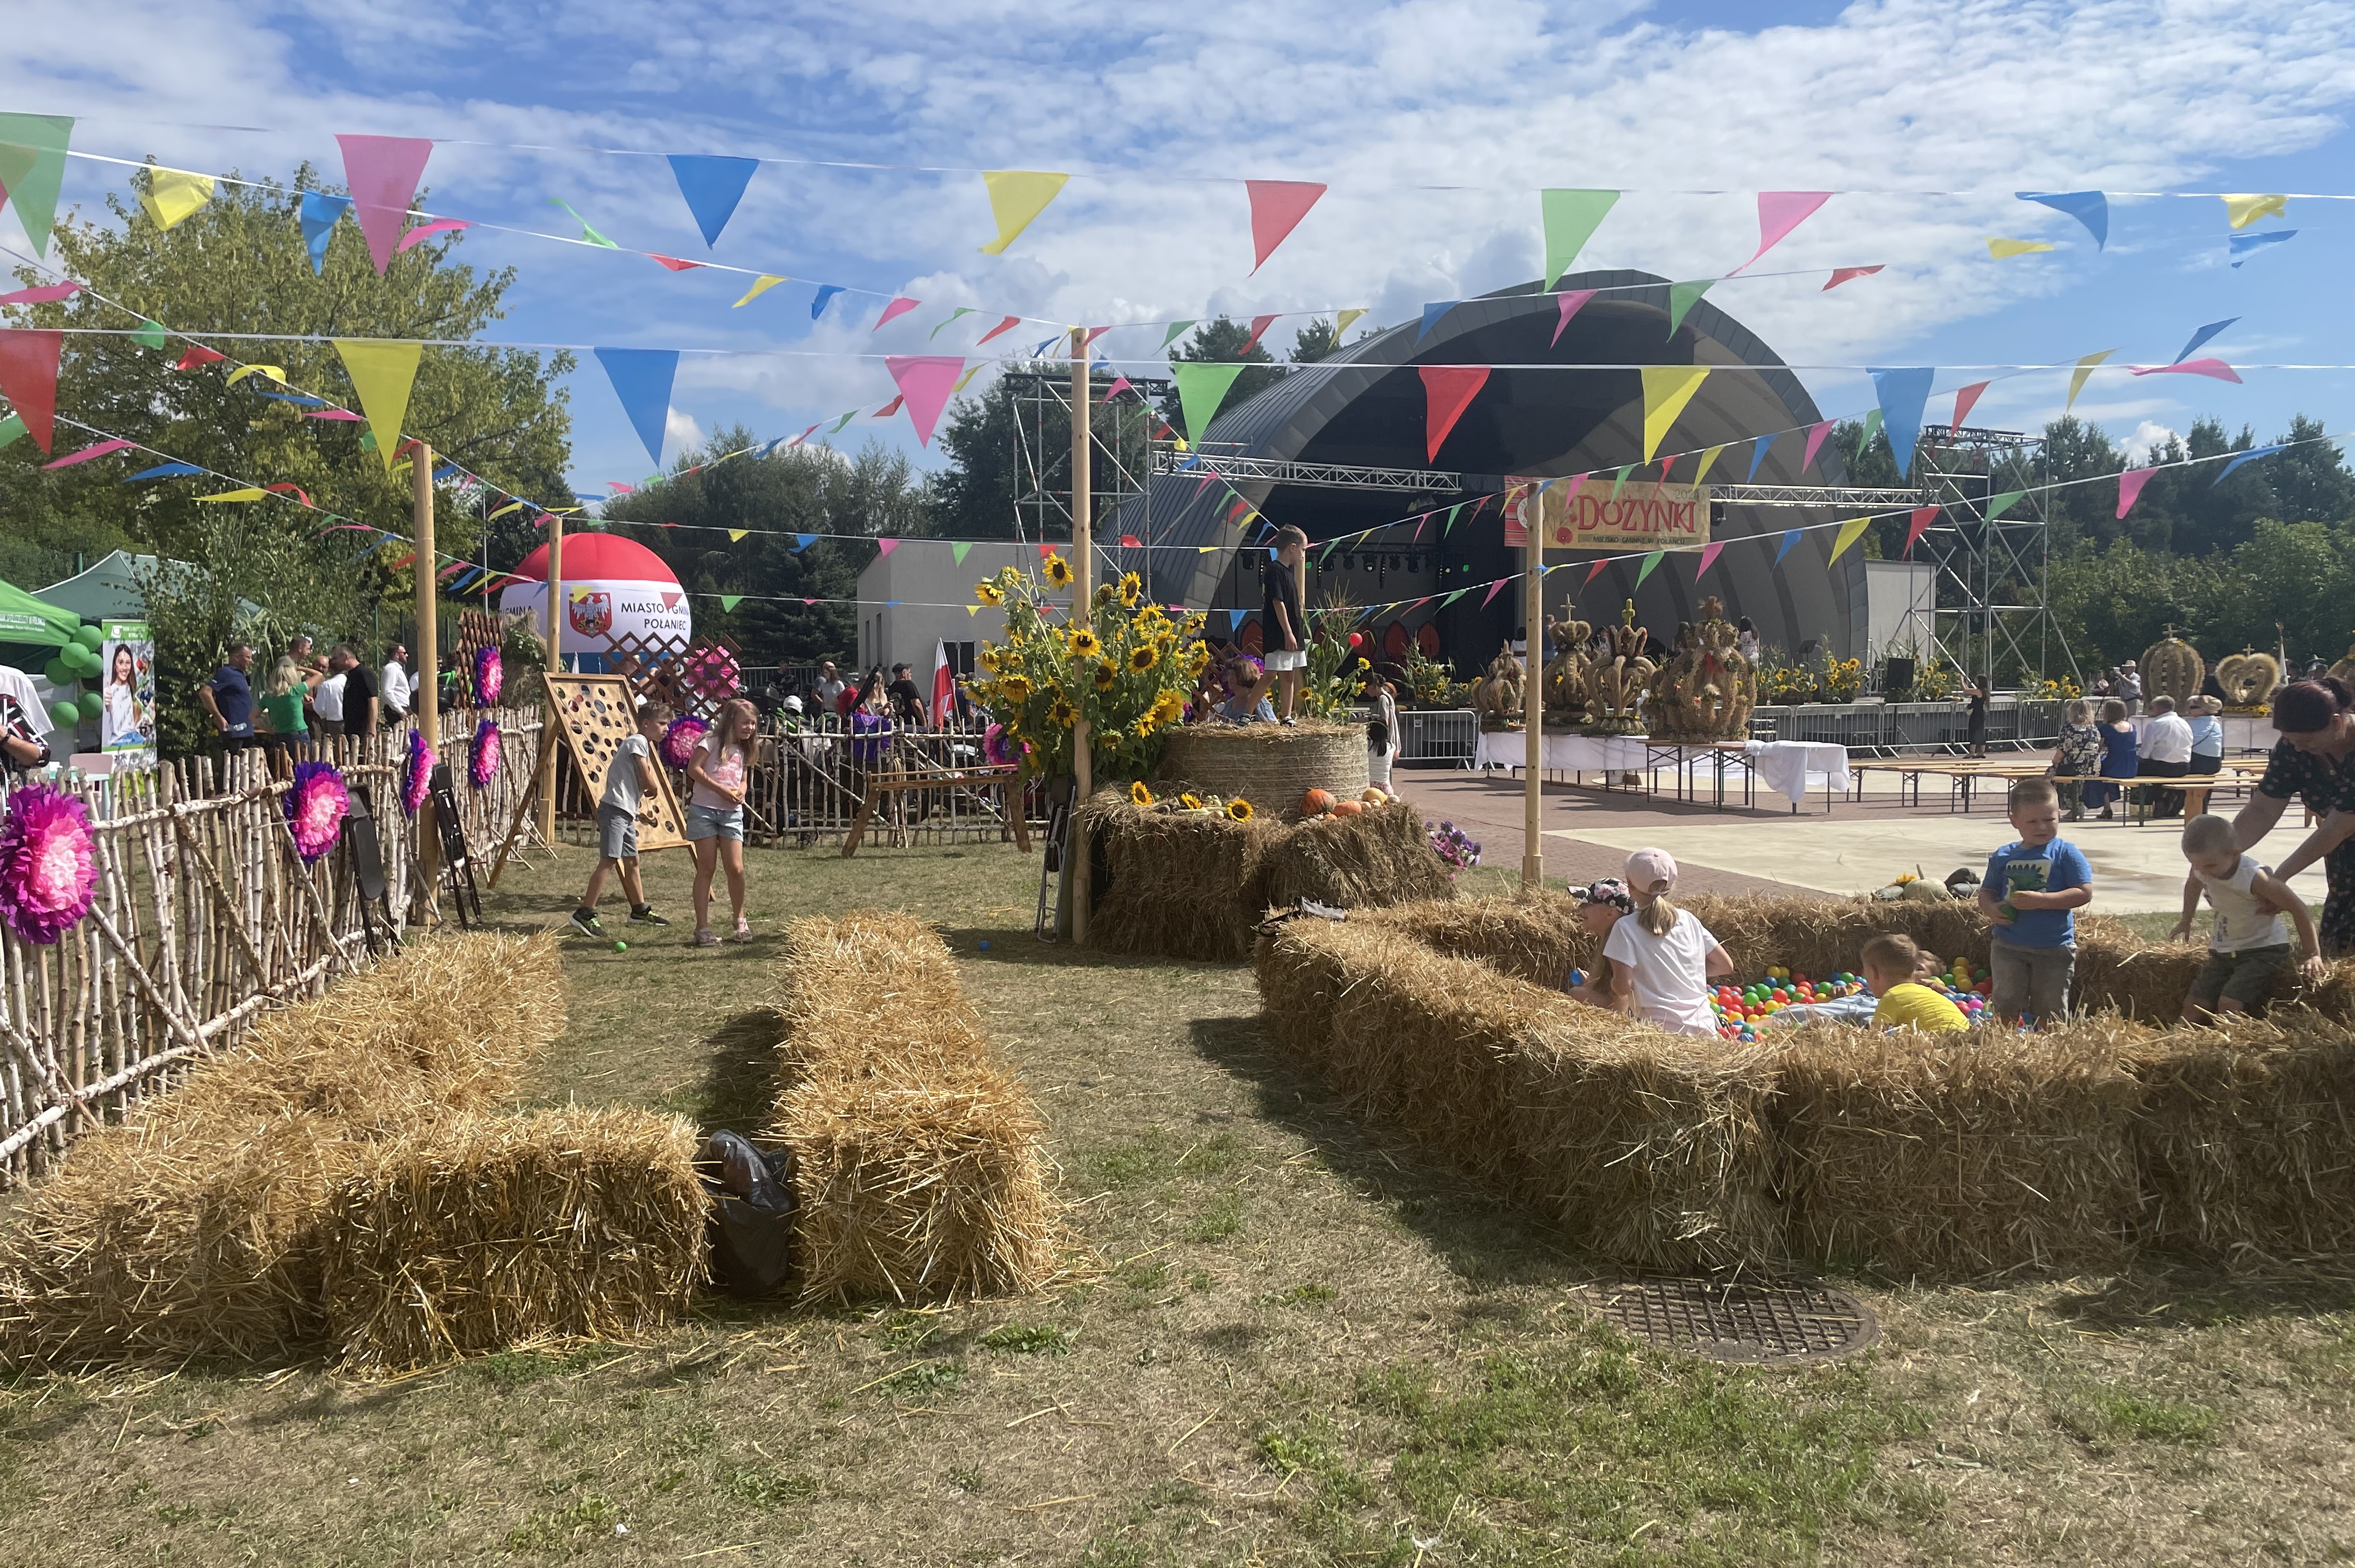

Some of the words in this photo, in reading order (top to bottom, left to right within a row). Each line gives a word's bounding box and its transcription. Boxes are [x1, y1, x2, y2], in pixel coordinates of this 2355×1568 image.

[1578, 494, 1696, 533] DOŻYNKI
[621, 602, 665, 613] MIASTO
[644, 619, 686, 630] POŁANIEC
